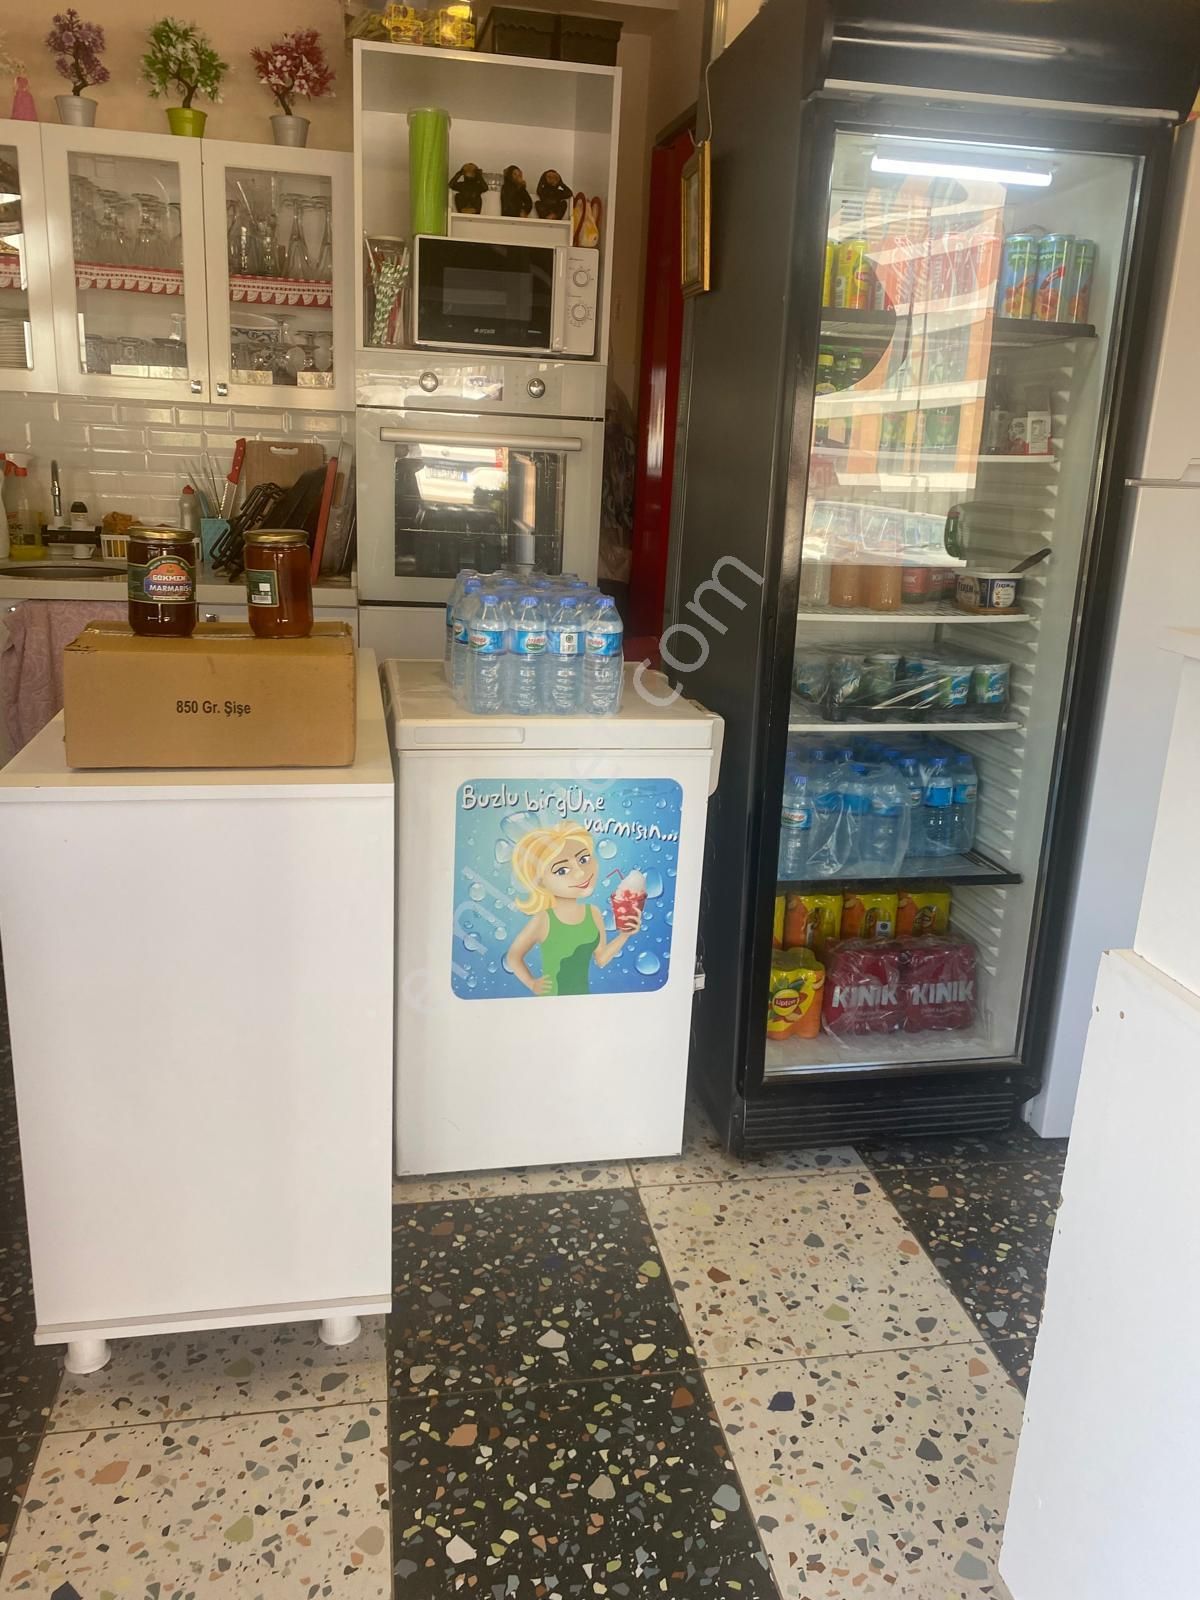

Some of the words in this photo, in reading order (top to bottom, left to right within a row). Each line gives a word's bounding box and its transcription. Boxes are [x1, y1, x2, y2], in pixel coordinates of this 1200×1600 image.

[176, 700, 199, 714] 850
[202, 700, 221, 714] Gr.
[224, 701, 251, 717] Şişe
[461, 785, 519, 810] Buzlu
[831, 983, 898, 1009] KINIK
[912, 980, 975, 1006] KINIK
